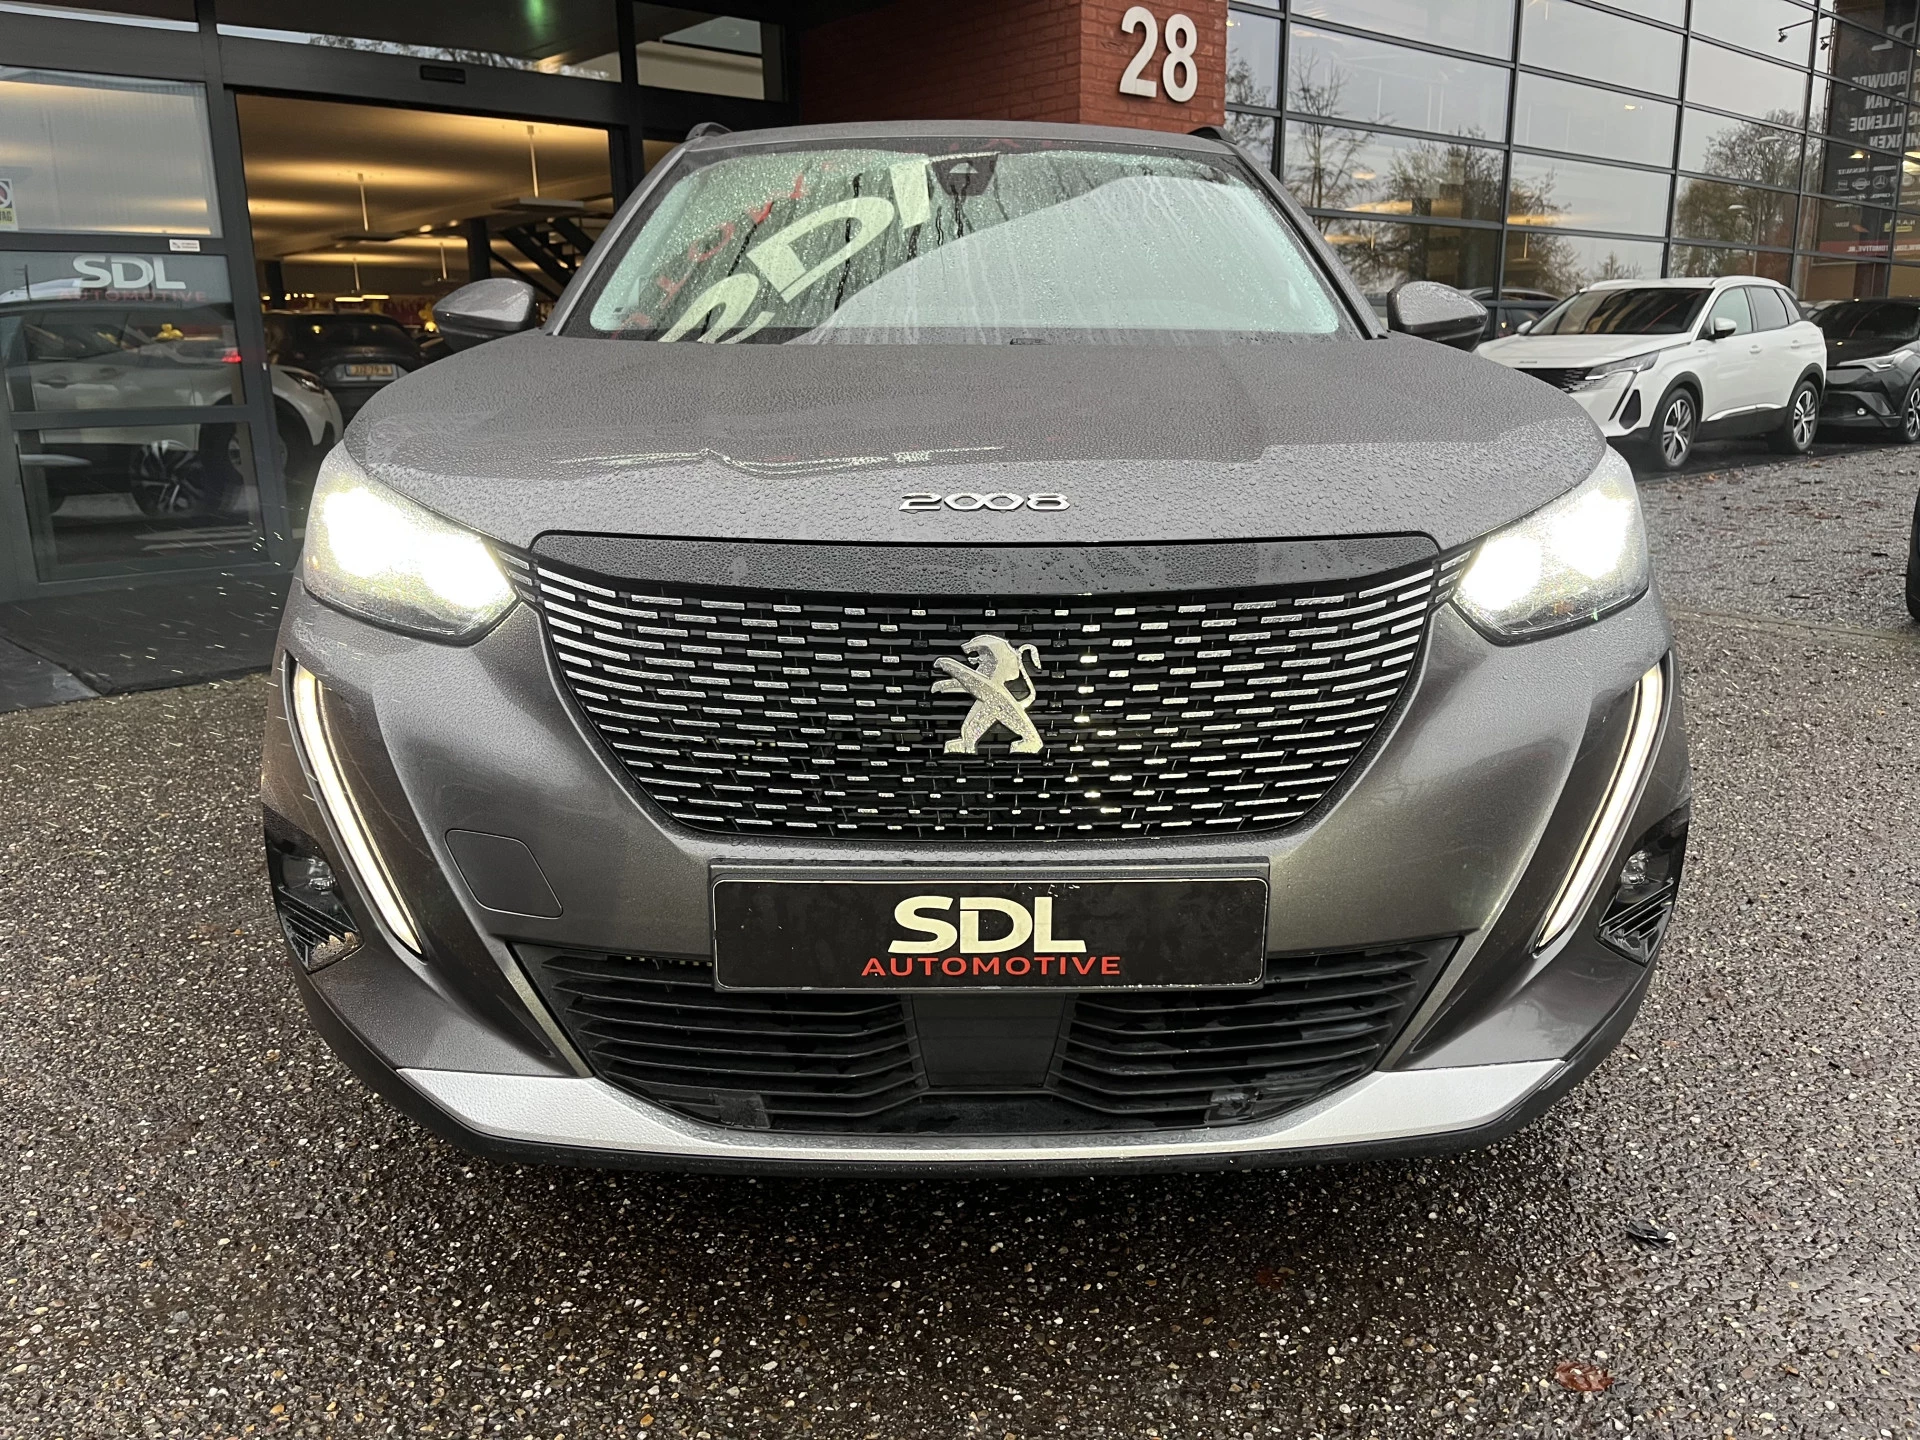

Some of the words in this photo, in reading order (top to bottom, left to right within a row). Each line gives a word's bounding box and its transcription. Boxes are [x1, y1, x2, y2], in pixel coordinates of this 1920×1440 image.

[1119, 6, 1198, 103] 28
[73, 254, 187, 290] SDL
[898, 492, 1071, 512] 2008
[888, 895, 1087, 954] SDL
[861, 955, 1121, 977] AUTOMOTIVE
